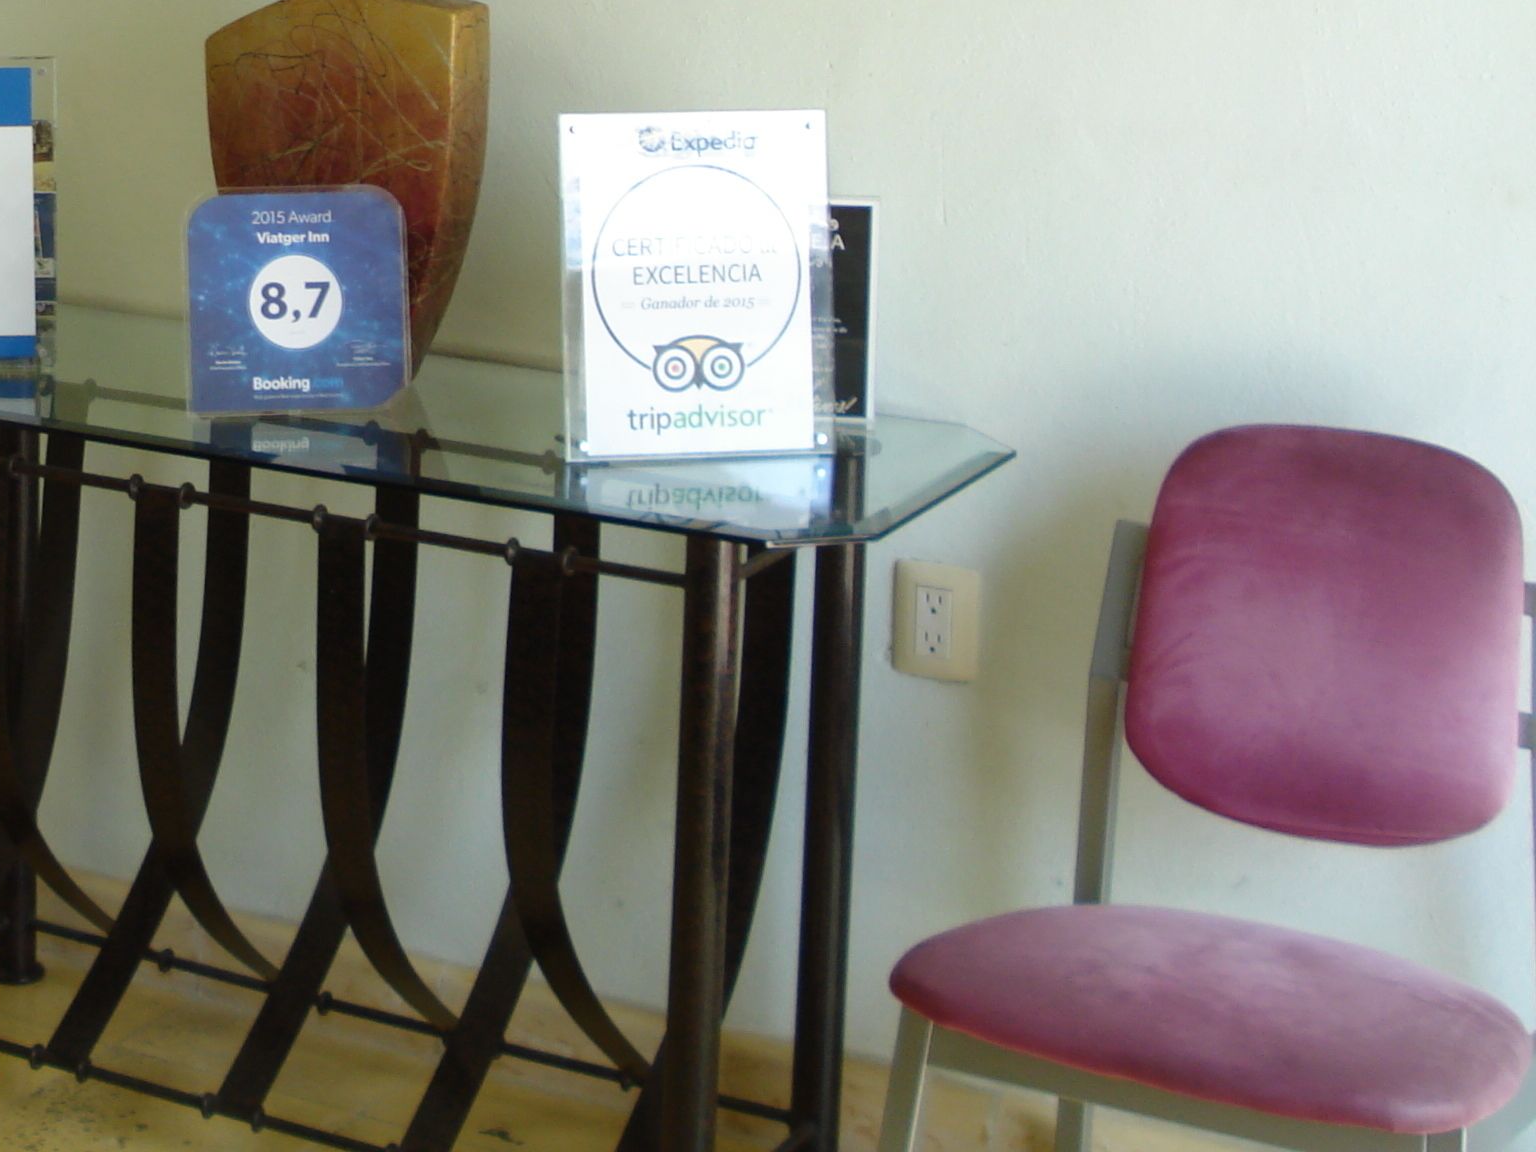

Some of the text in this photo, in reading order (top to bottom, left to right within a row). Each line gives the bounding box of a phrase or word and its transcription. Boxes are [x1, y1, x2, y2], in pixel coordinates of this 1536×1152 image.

[251, 209, 332, 225] 2015 Award
[256, 230, 330, 246] Viatger Inn
[612, 234, 754, 257] CERTFCADO
[632, 263, 762, 286] EXCELENCIA
[260, 281, 331, 323] 8,7
[640, 296, 755, 311] Ganador de 2015
[627, 404, 766, 435] tripadvisor
